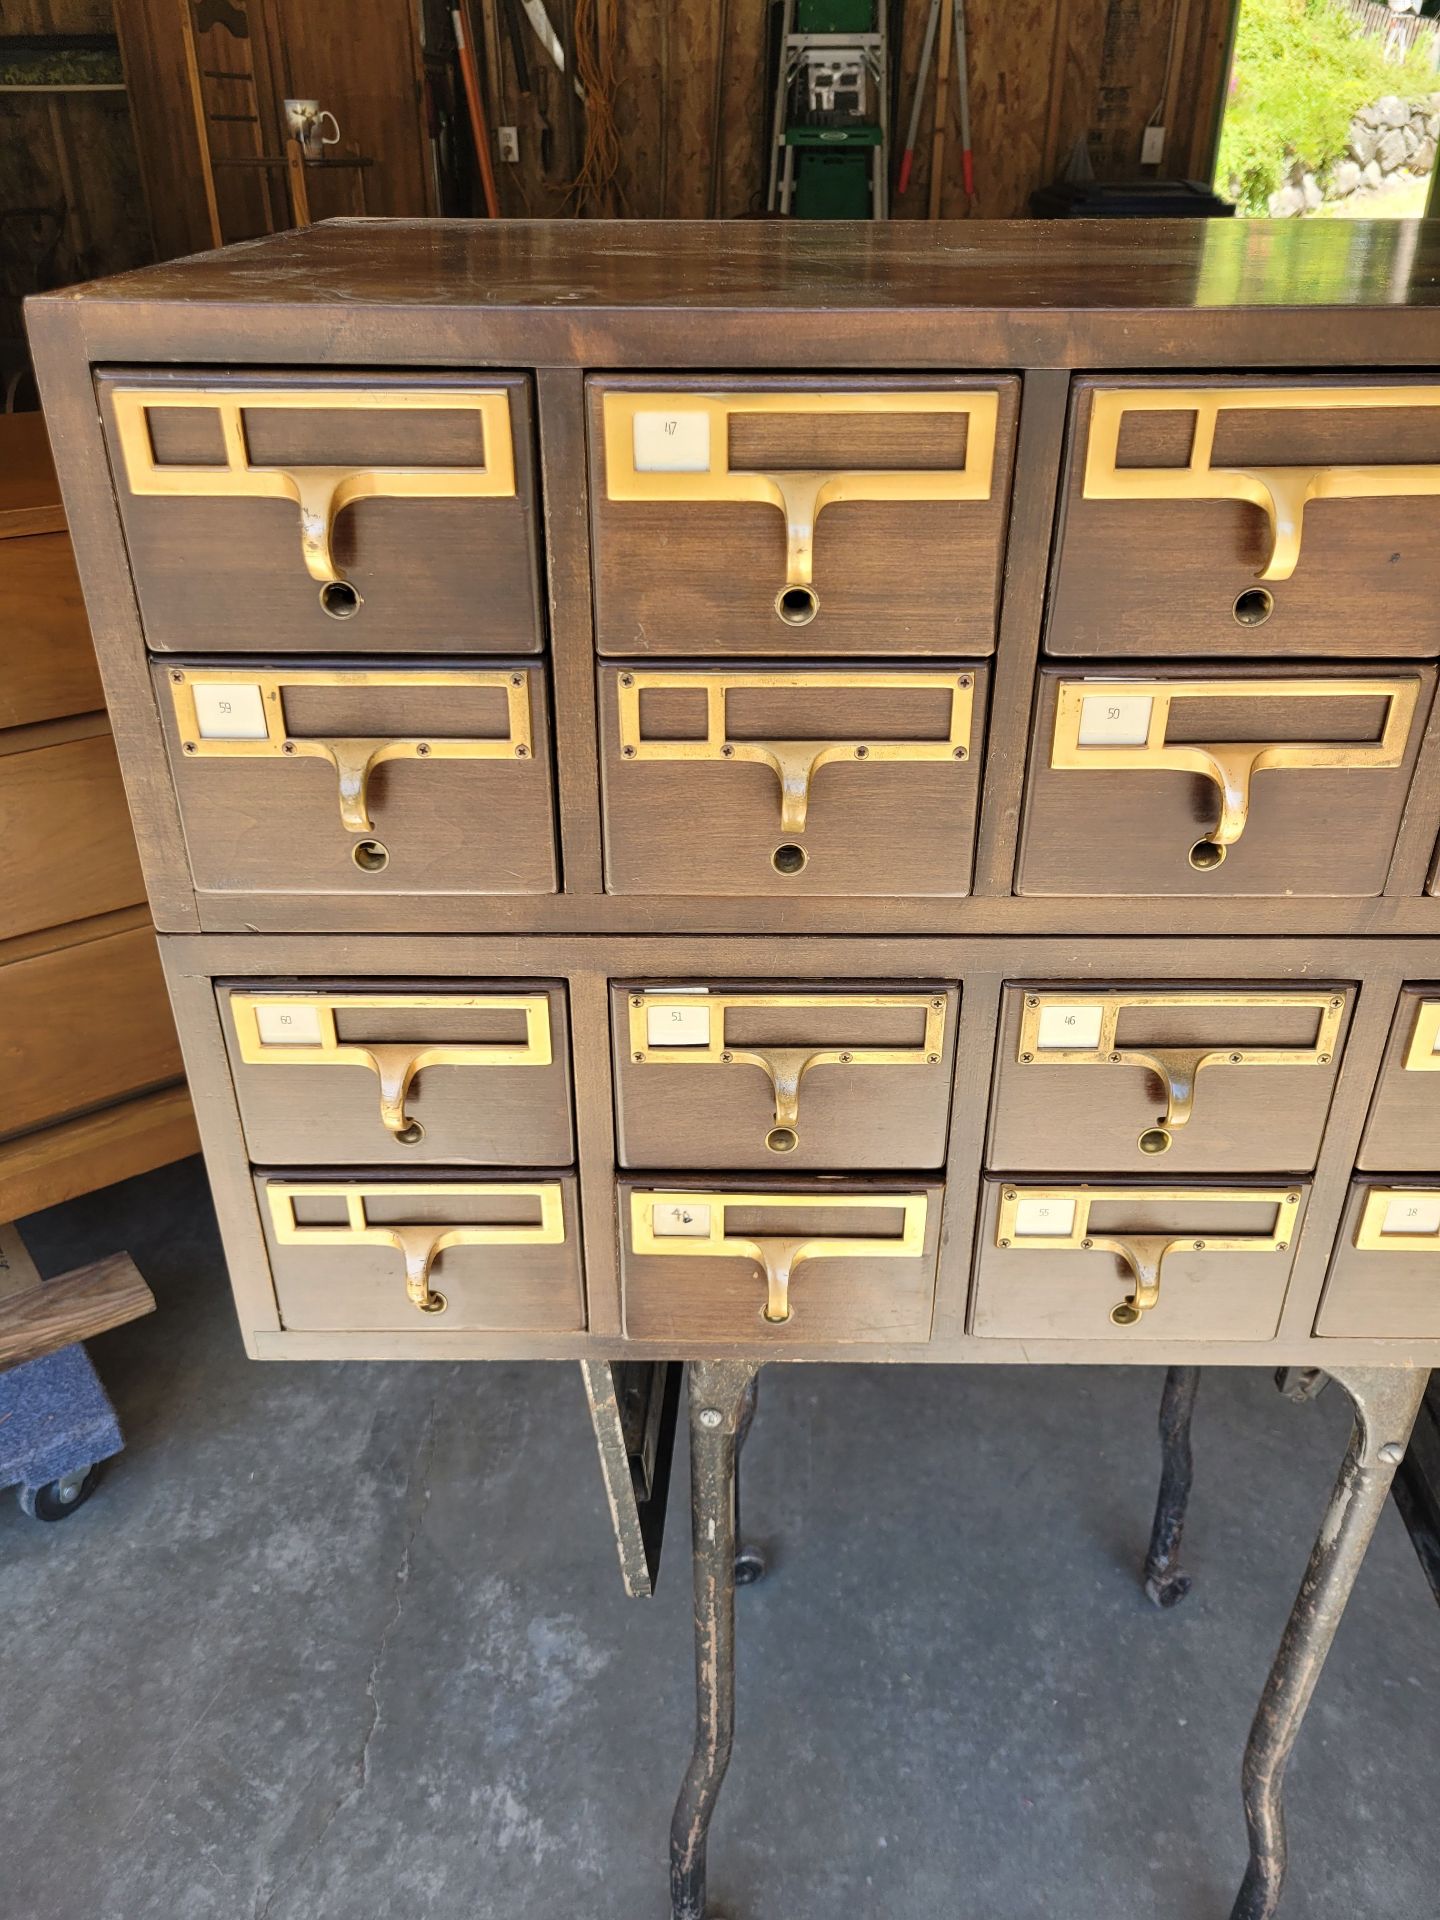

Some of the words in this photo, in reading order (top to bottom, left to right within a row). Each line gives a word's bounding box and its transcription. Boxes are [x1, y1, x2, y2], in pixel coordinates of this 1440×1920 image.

[218, 702, 232, 713] 59
[1106, 707, 1121, 720] 50
[671, 1011, 684, 1022] 51
[1064, 1015, 1076, 1026] 46
